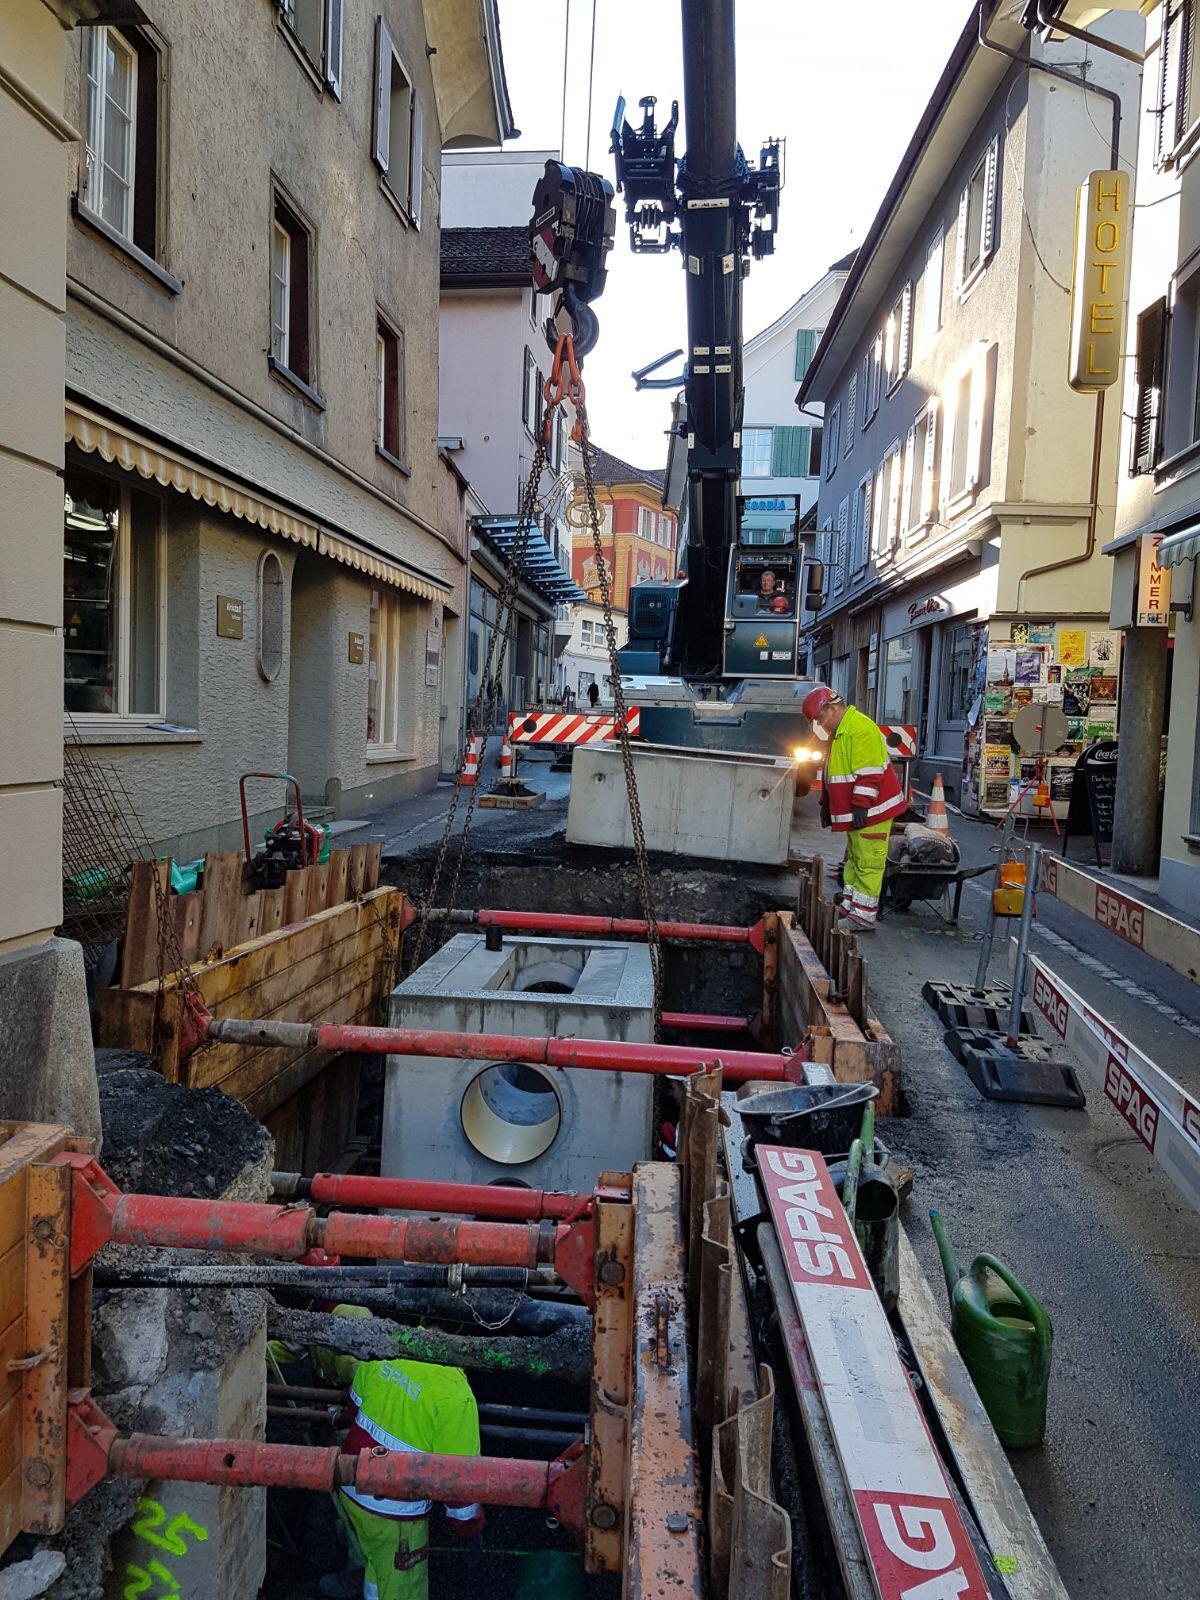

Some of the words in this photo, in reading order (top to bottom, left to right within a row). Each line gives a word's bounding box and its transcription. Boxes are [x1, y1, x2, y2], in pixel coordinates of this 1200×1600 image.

[1088, 179, 1121, 374] HOTEL
[1096, 892, 1143, 944] SPAG
[1035, 975, 1068, 1035] SPAG
[1106, 1062, 1156, 1141] SPAG
[765, 1150, 856, 1280] SPAG
[379, 1360, 423, 1401] SPAG
[134, 1499, 208, 1556] 25
